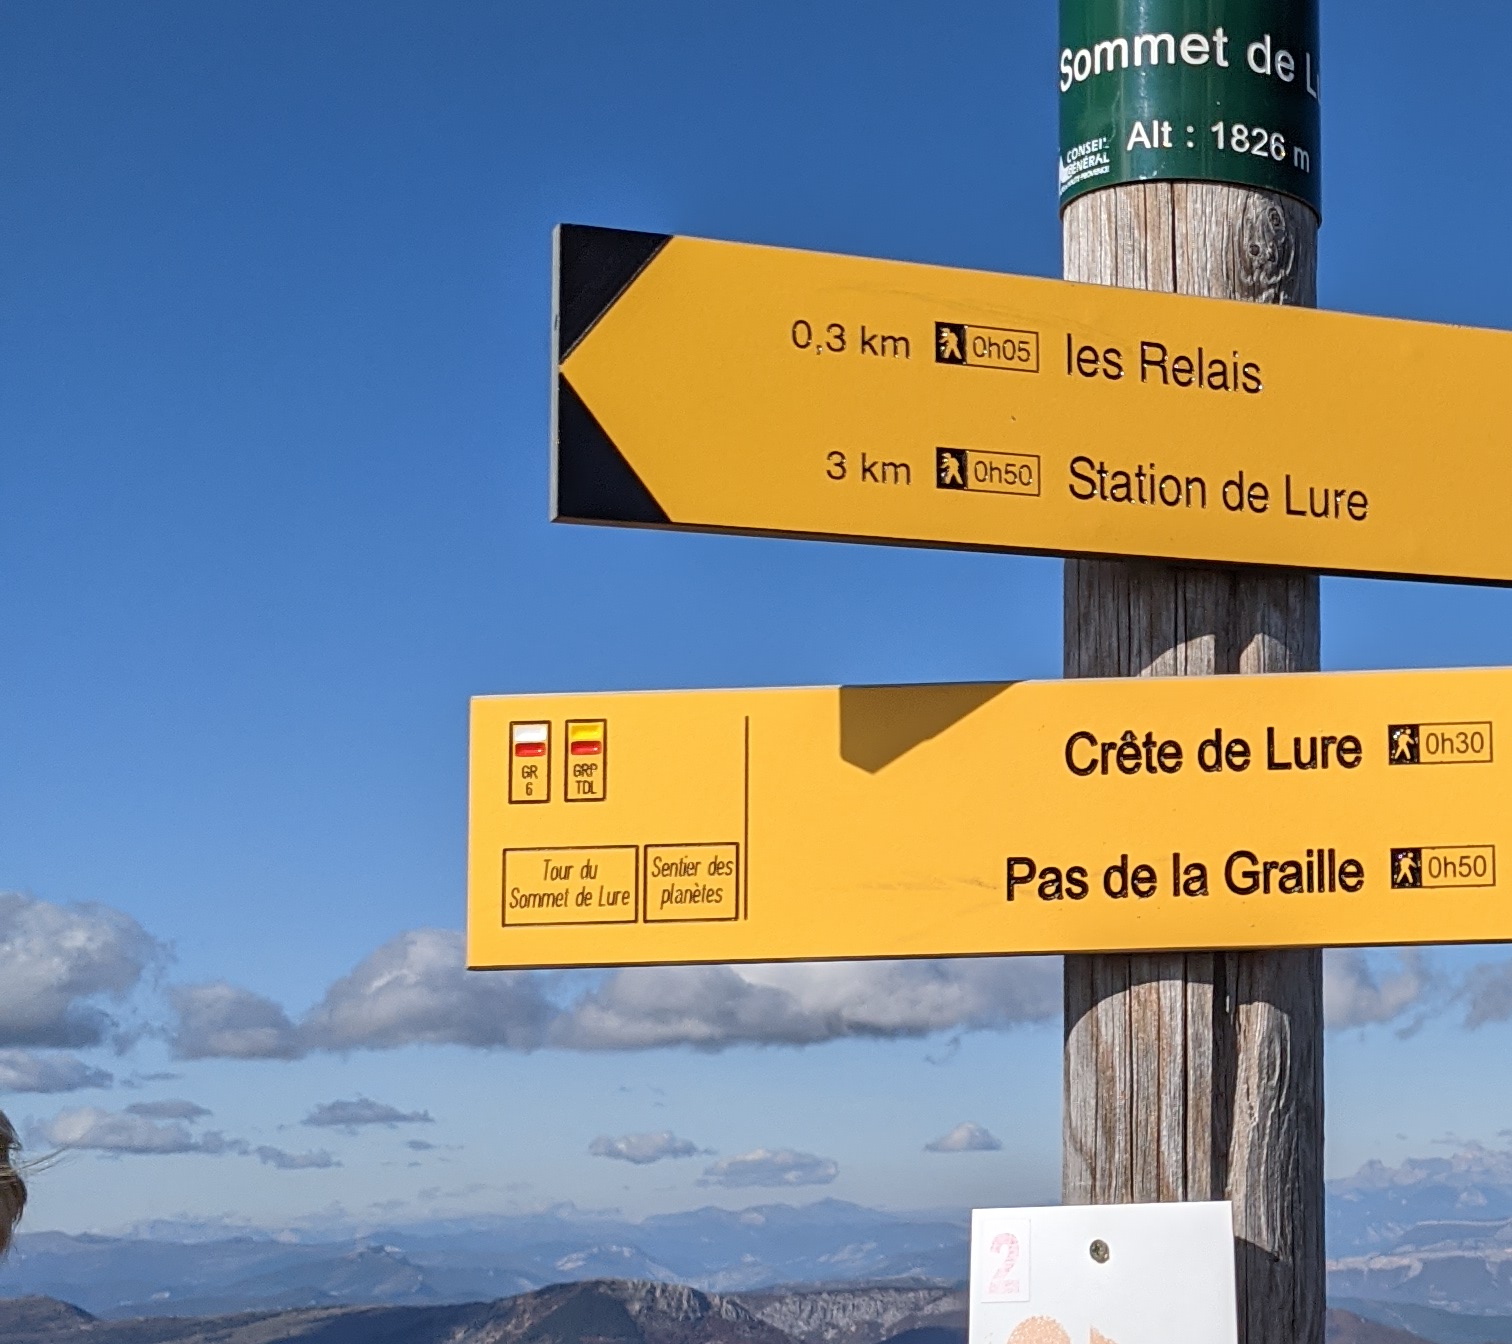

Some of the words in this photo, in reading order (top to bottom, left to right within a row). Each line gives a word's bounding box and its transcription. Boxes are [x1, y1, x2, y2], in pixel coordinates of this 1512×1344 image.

[1060, 26, 1229, 93] Sommet
[1247, 34, 1295, 83] de
[1126, 120, 1173, 151] Alt
[1211, 121, 1287, 162] 1826
[1294, 146, 1311, 174] m
[792, 319, 847, 355] 0,3
[861, 325, 911, 359] km
[972, 336, 1031, 362] 0h05
[1066, 332, 1124, 381] les
[1140, 340, 1263, 394] Relais
[826, 450, 847, 481] 3
[861, 452, 912, 485] km
[974, 460, 1033, 486] 0h50
[1068, 455, 1207, 509] Station
[1222, 470, 1270, 514] de
[1285, 474, 1370, 522] Lure
[1065, 729, 1183, 777] Crête
[1197, 728, 1251, 773] de
[1267, 726, 1363, 771] Lure
[1425, 731, 1485, 755] 0h30
[521, 764, 539, 779] GR
[573, 763, 598, 777] GRP
[525, 781, 534, 796] 6
[575, 780, 597, 795] TDL
[542, 859, 574, 882] Tour
[580, 858, 599, 880] du
[651, 855, 702, 878] Sentier
[708, 855, 734, 876] des
[1006, 856, 1089, 901] Pas
[1103, 854, 1157, 899] de
[1172, 852, 1209, 897] la
[1224, 848, 1365, 896] Graille
[1428, 855, 1487, 879] 0h50
[509, 887, 570, 909] Sommet
[575, 886, 593, 907] de
[598, 885, 631, 907] Lure
[660, 882, 724, 910] planètes
[987, 1232, 1021, 1295] 2
